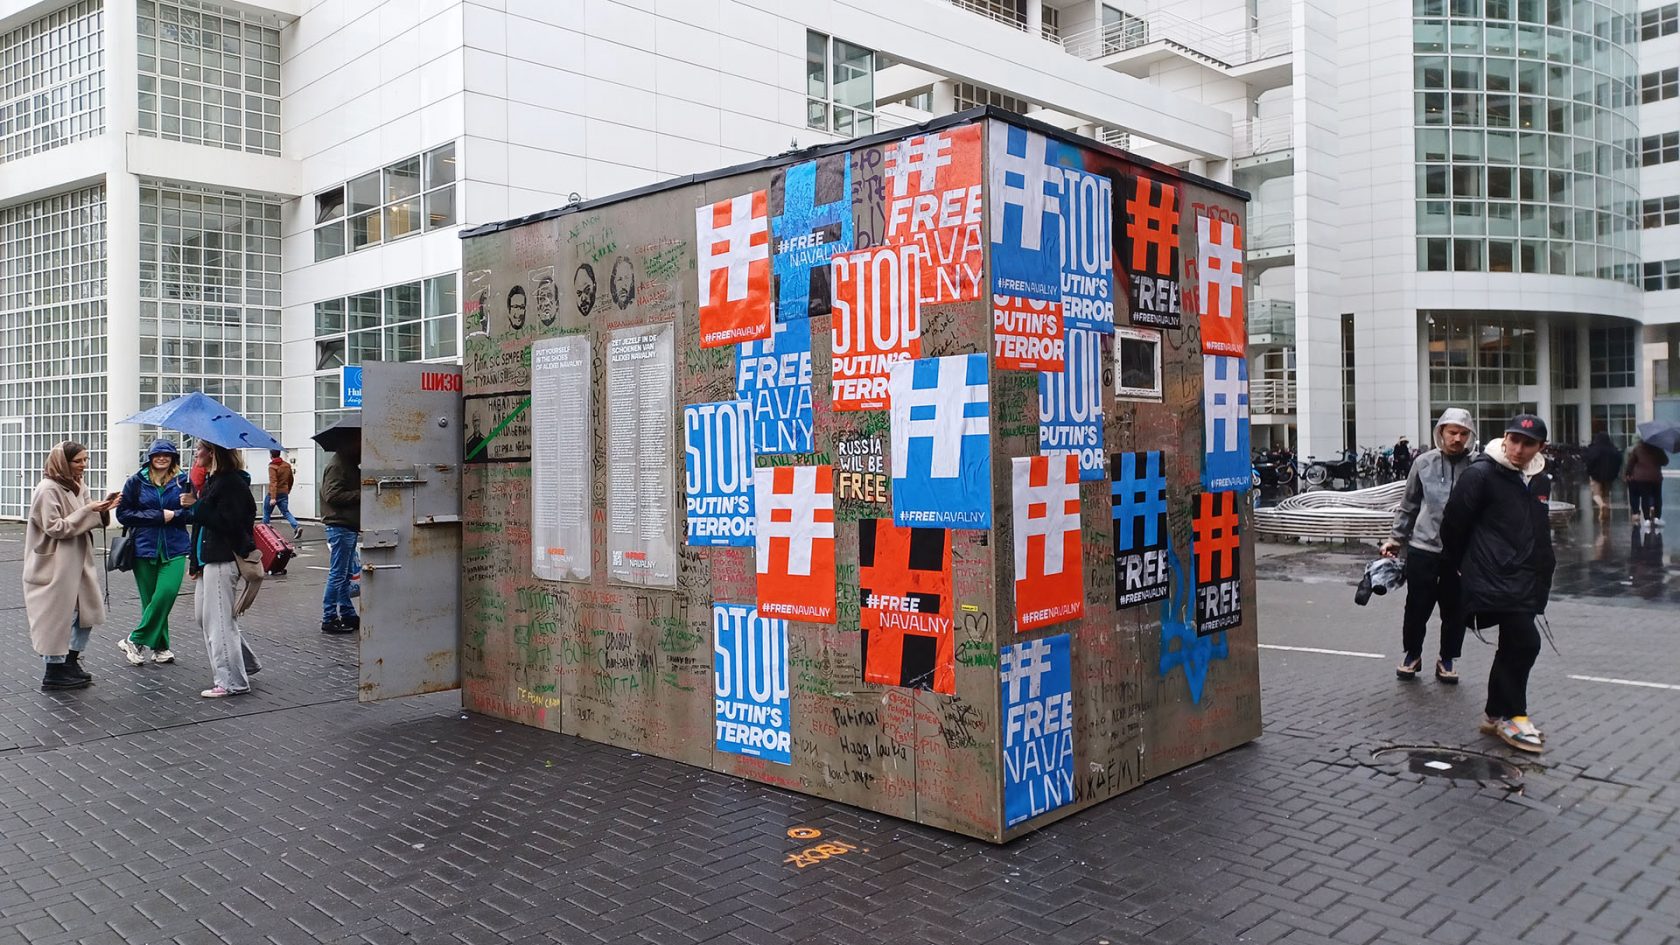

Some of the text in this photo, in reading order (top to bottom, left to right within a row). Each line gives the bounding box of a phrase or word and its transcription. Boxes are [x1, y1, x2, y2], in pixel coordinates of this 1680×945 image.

[889, 185, 982, 236] FREE
[777, 231, 824, 254] #FREE
[790, 241, 851, 268] NAVALNY
[885, 224, 982, 267] AVA
[998, 277, 1058, 296] #FREENAVALNY
[1061, 273, 1107, 298] UTIN'S
[832, 245, 920, 354] STOP
[1063, 296, 1113, 322] ERROR
[705, 323, 766, 343] #FREENAVALNY
[994, 310, 1057, 335] PUTIN'S
[995, 336, 1064, 361] TERROR
[421, 372, 462, 392] ШИЗО
[738, 351, 812, 391] FREE
[832, 377, 890, 400] TERR
[685, 402, 754, 494] STOP
[1040, 425, 1097, 446] PUTIN'S
[868, 456, 883, 472] BE
[839, 472, 887, 503] FREE
[687, 496, 749, 514] PUTIN'S
[900, 510, 985, 522] #FREENAVALNY
[687, 517, 756, 536] TERROR
[1117, 549, 1168, 590] FREE
[866, 594, 920, 612] #FREE
[1120, 587, 1167, 605] #FREENAVALNY
[1198, 581, 1241, 618] FREE
[762, 602, 831, 618] #FREENAVALNY
[1022, 602, 1080, 624] #FREENAVALNY
[879, 612, 950, 634] NAVALNY
[715, 606, 789, 704] STOP
[715, 700, 782, 727] PUTIN'S
[1006, 692, 1072, 747] FREE
[715, 720, 791, 753] TERROR
[1004, 730, 1073, 787] NAVA
[1029, 772, 1074, 816] LNY
